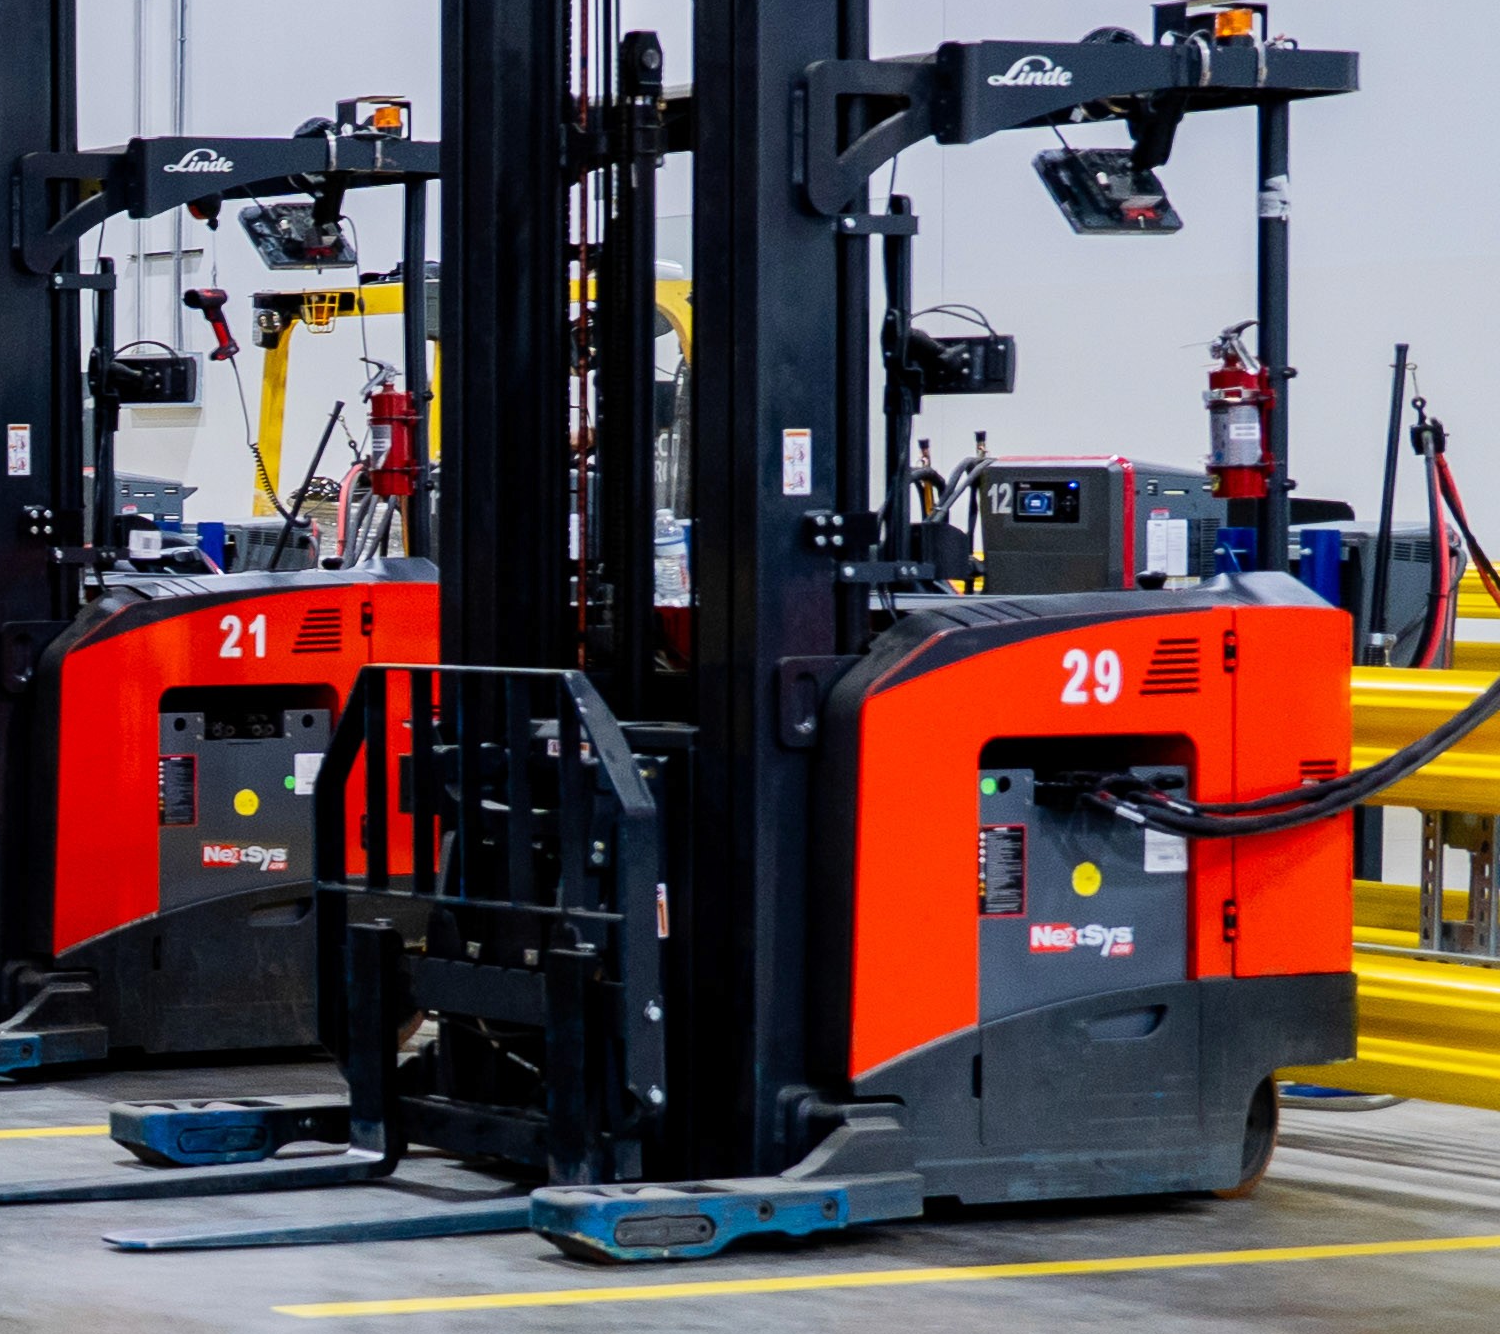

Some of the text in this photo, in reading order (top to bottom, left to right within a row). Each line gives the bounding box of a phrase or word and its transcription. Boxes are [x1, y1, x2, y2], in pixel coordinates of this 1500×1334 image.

[987, 55, 1073, 86] Linde
[163, 148, 234, 173] Linde
[987, 482, 1013, 515] 12
[218, 614, 267, 658] 21
[1061, 648, 1123, 705] 29
